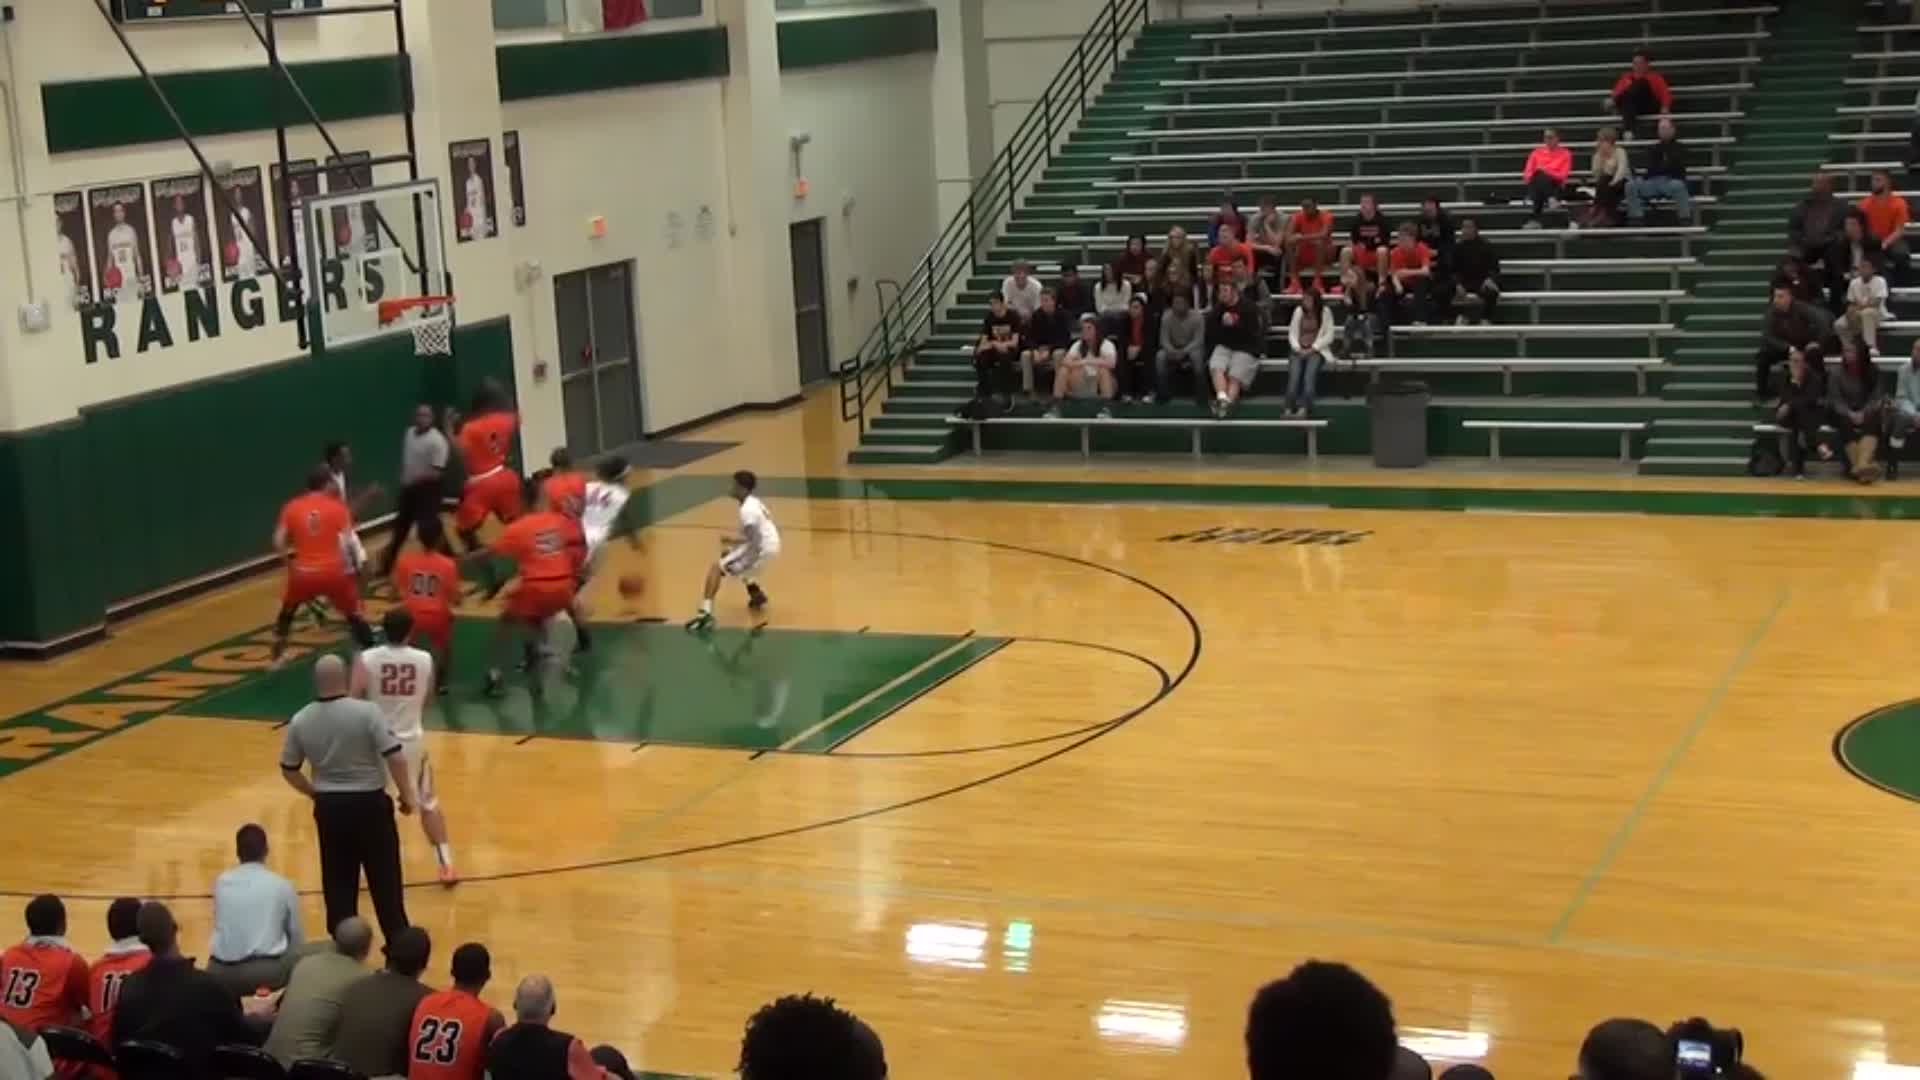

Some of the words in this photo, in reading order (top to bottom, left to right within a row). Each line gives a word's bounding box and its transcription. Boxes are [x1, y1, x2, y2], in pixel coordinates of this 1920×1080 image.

[80, 256, 385, 364] RANGERS
[381, 663, 417, 696] 22
[4, 967, 41, 1009] 13
[414, 1015, 463, 1066] 23
